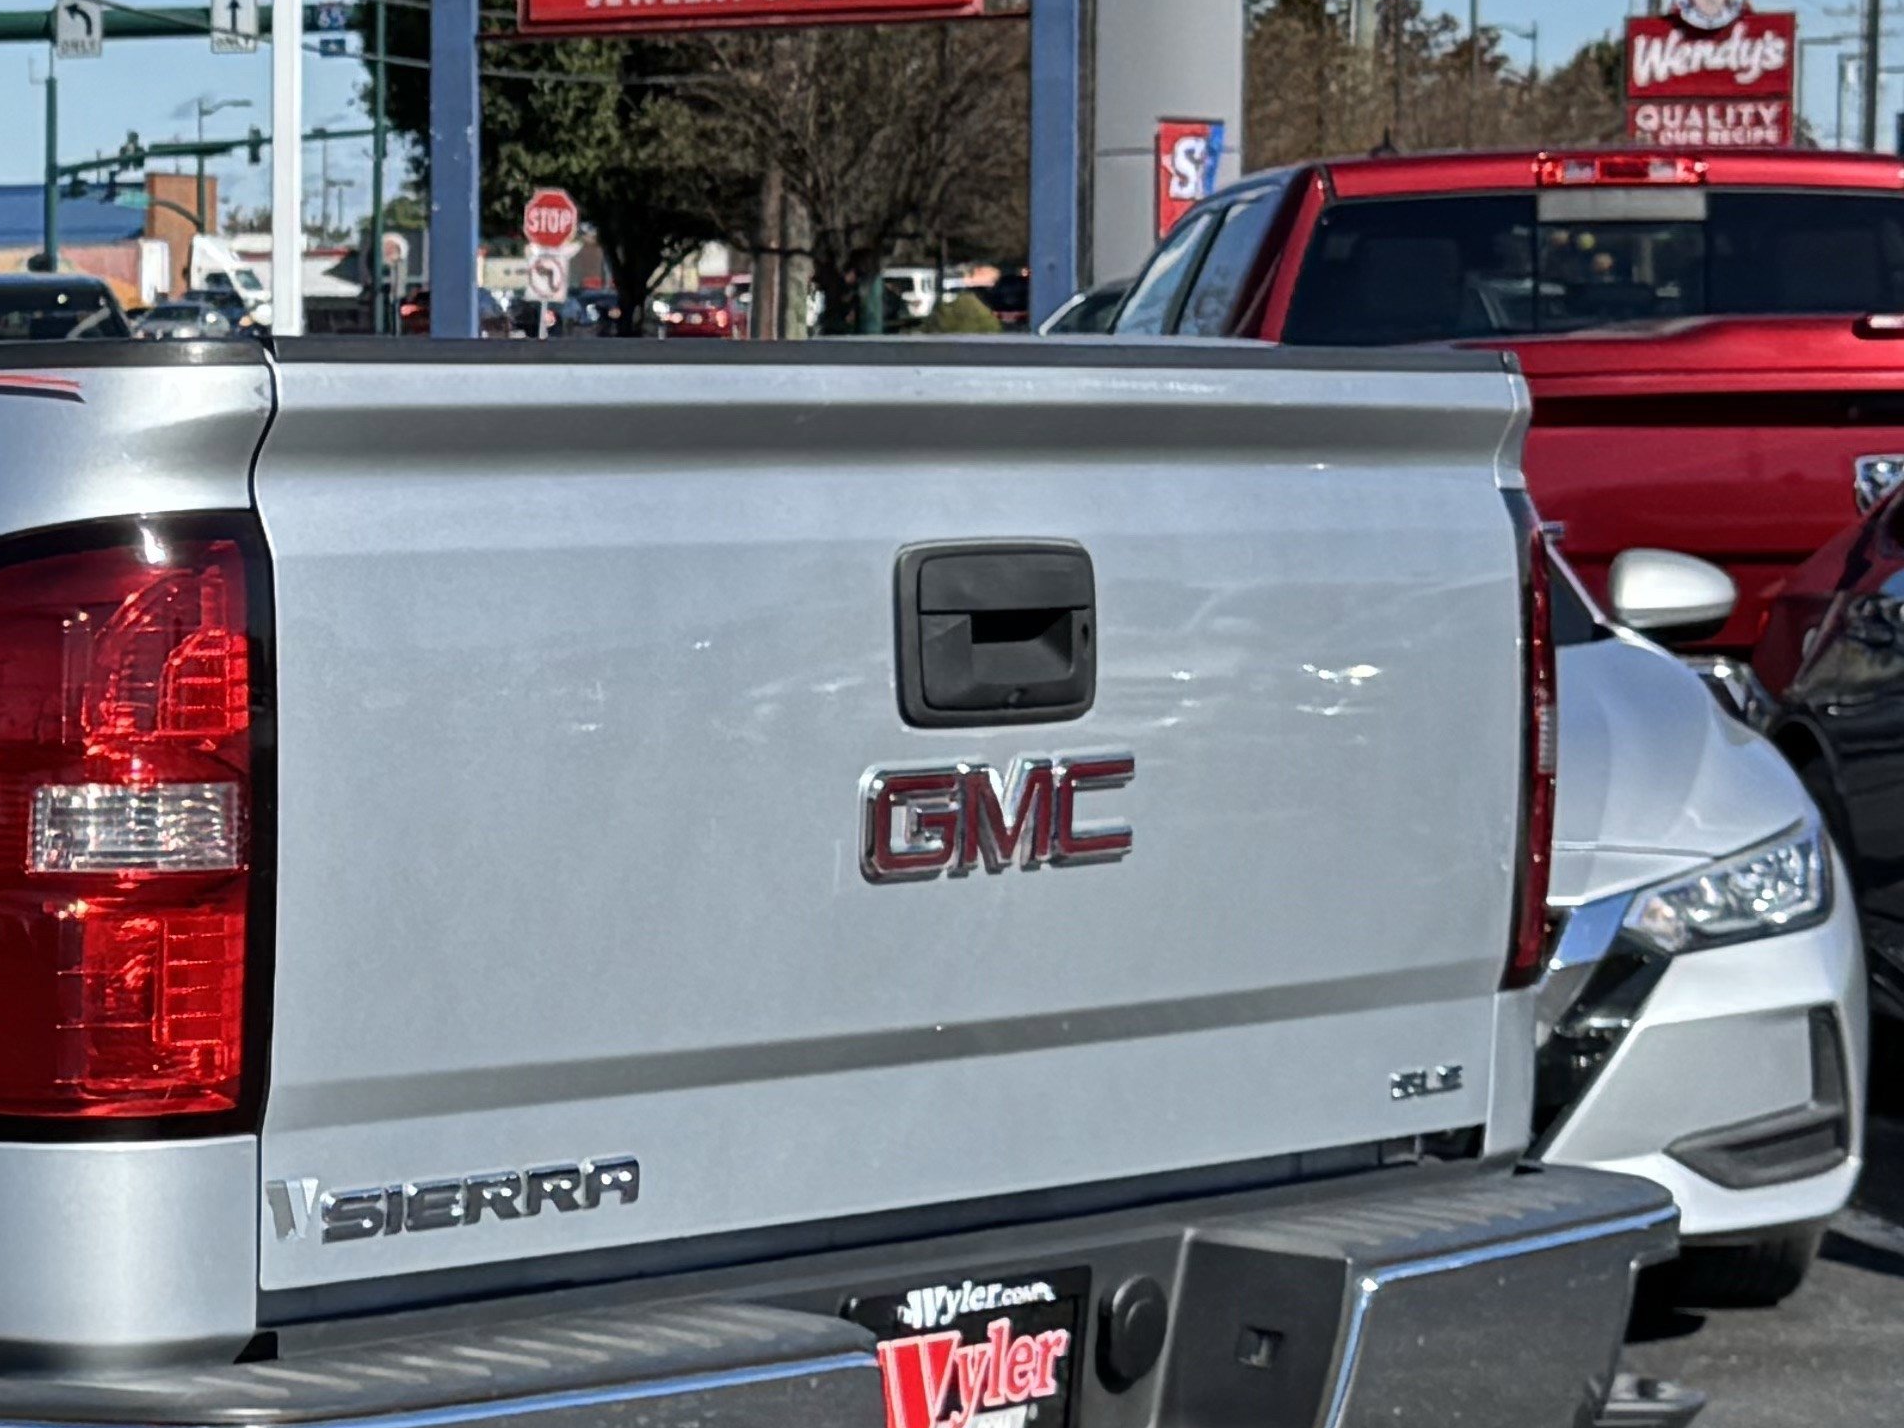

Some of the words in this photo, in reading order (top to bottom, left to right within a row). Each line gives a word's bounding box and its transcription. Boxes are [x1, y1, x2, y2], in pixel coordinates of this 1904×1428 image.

[1632, 21, 1786, 88] Wendy's
[1635, 103, 1779, 131] QUALITY
[527, 206, 572, 233] STOP
[859, 746, 1135, 884] GMC
[321, 1151, 641, 1245] SIERRA
